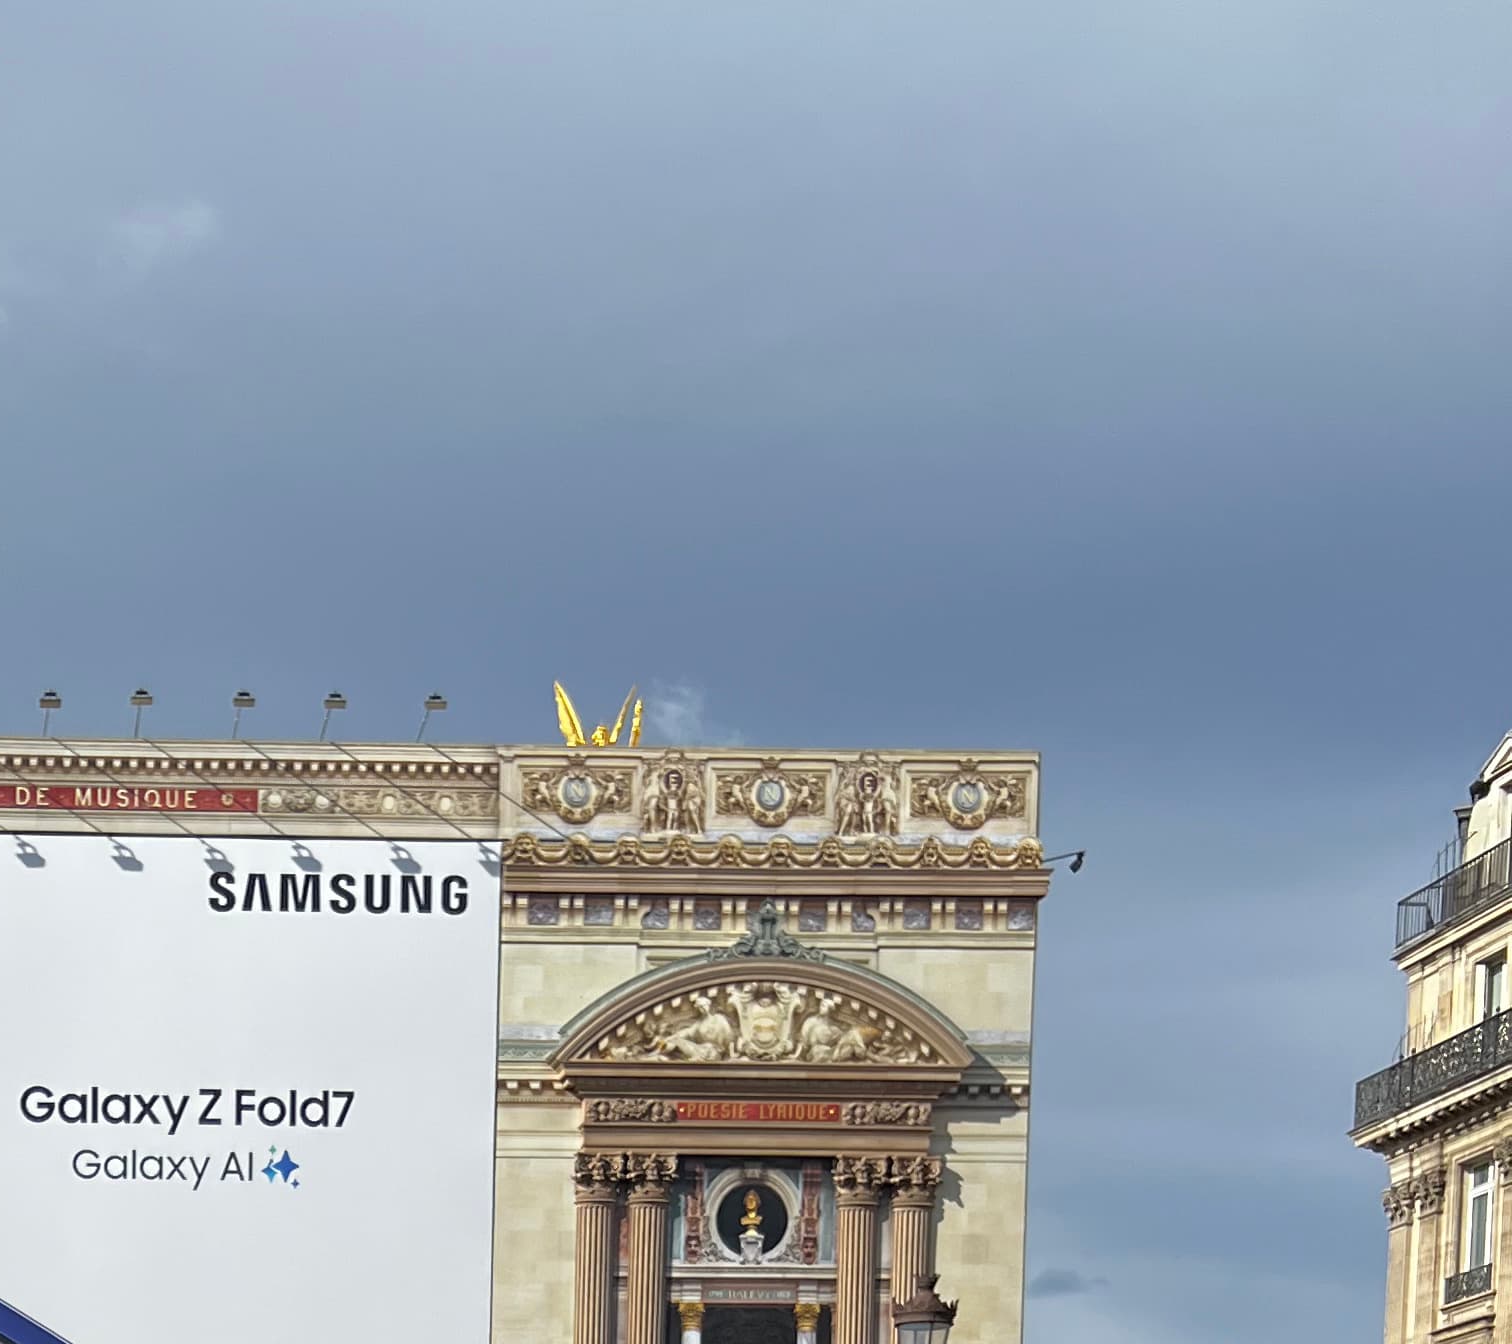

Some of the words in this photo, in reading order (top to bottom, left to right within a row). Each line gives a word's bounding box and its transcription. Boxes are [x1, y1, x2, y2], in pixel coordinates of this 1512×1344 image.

[15, 786, 49, 806] DE
[74, 787, 198, 809] MUSIQUE
[208, 871, 469, 915] SAMSUNG
[19, 1085, 189, 1135] Galaxy
[198, 1088, 223, 1126] Z
[234, 1090, 355, 1128] Fold7
[72, 1149, 211, 1191] Galaxy
[220, 1151, 254, 1182] AI
